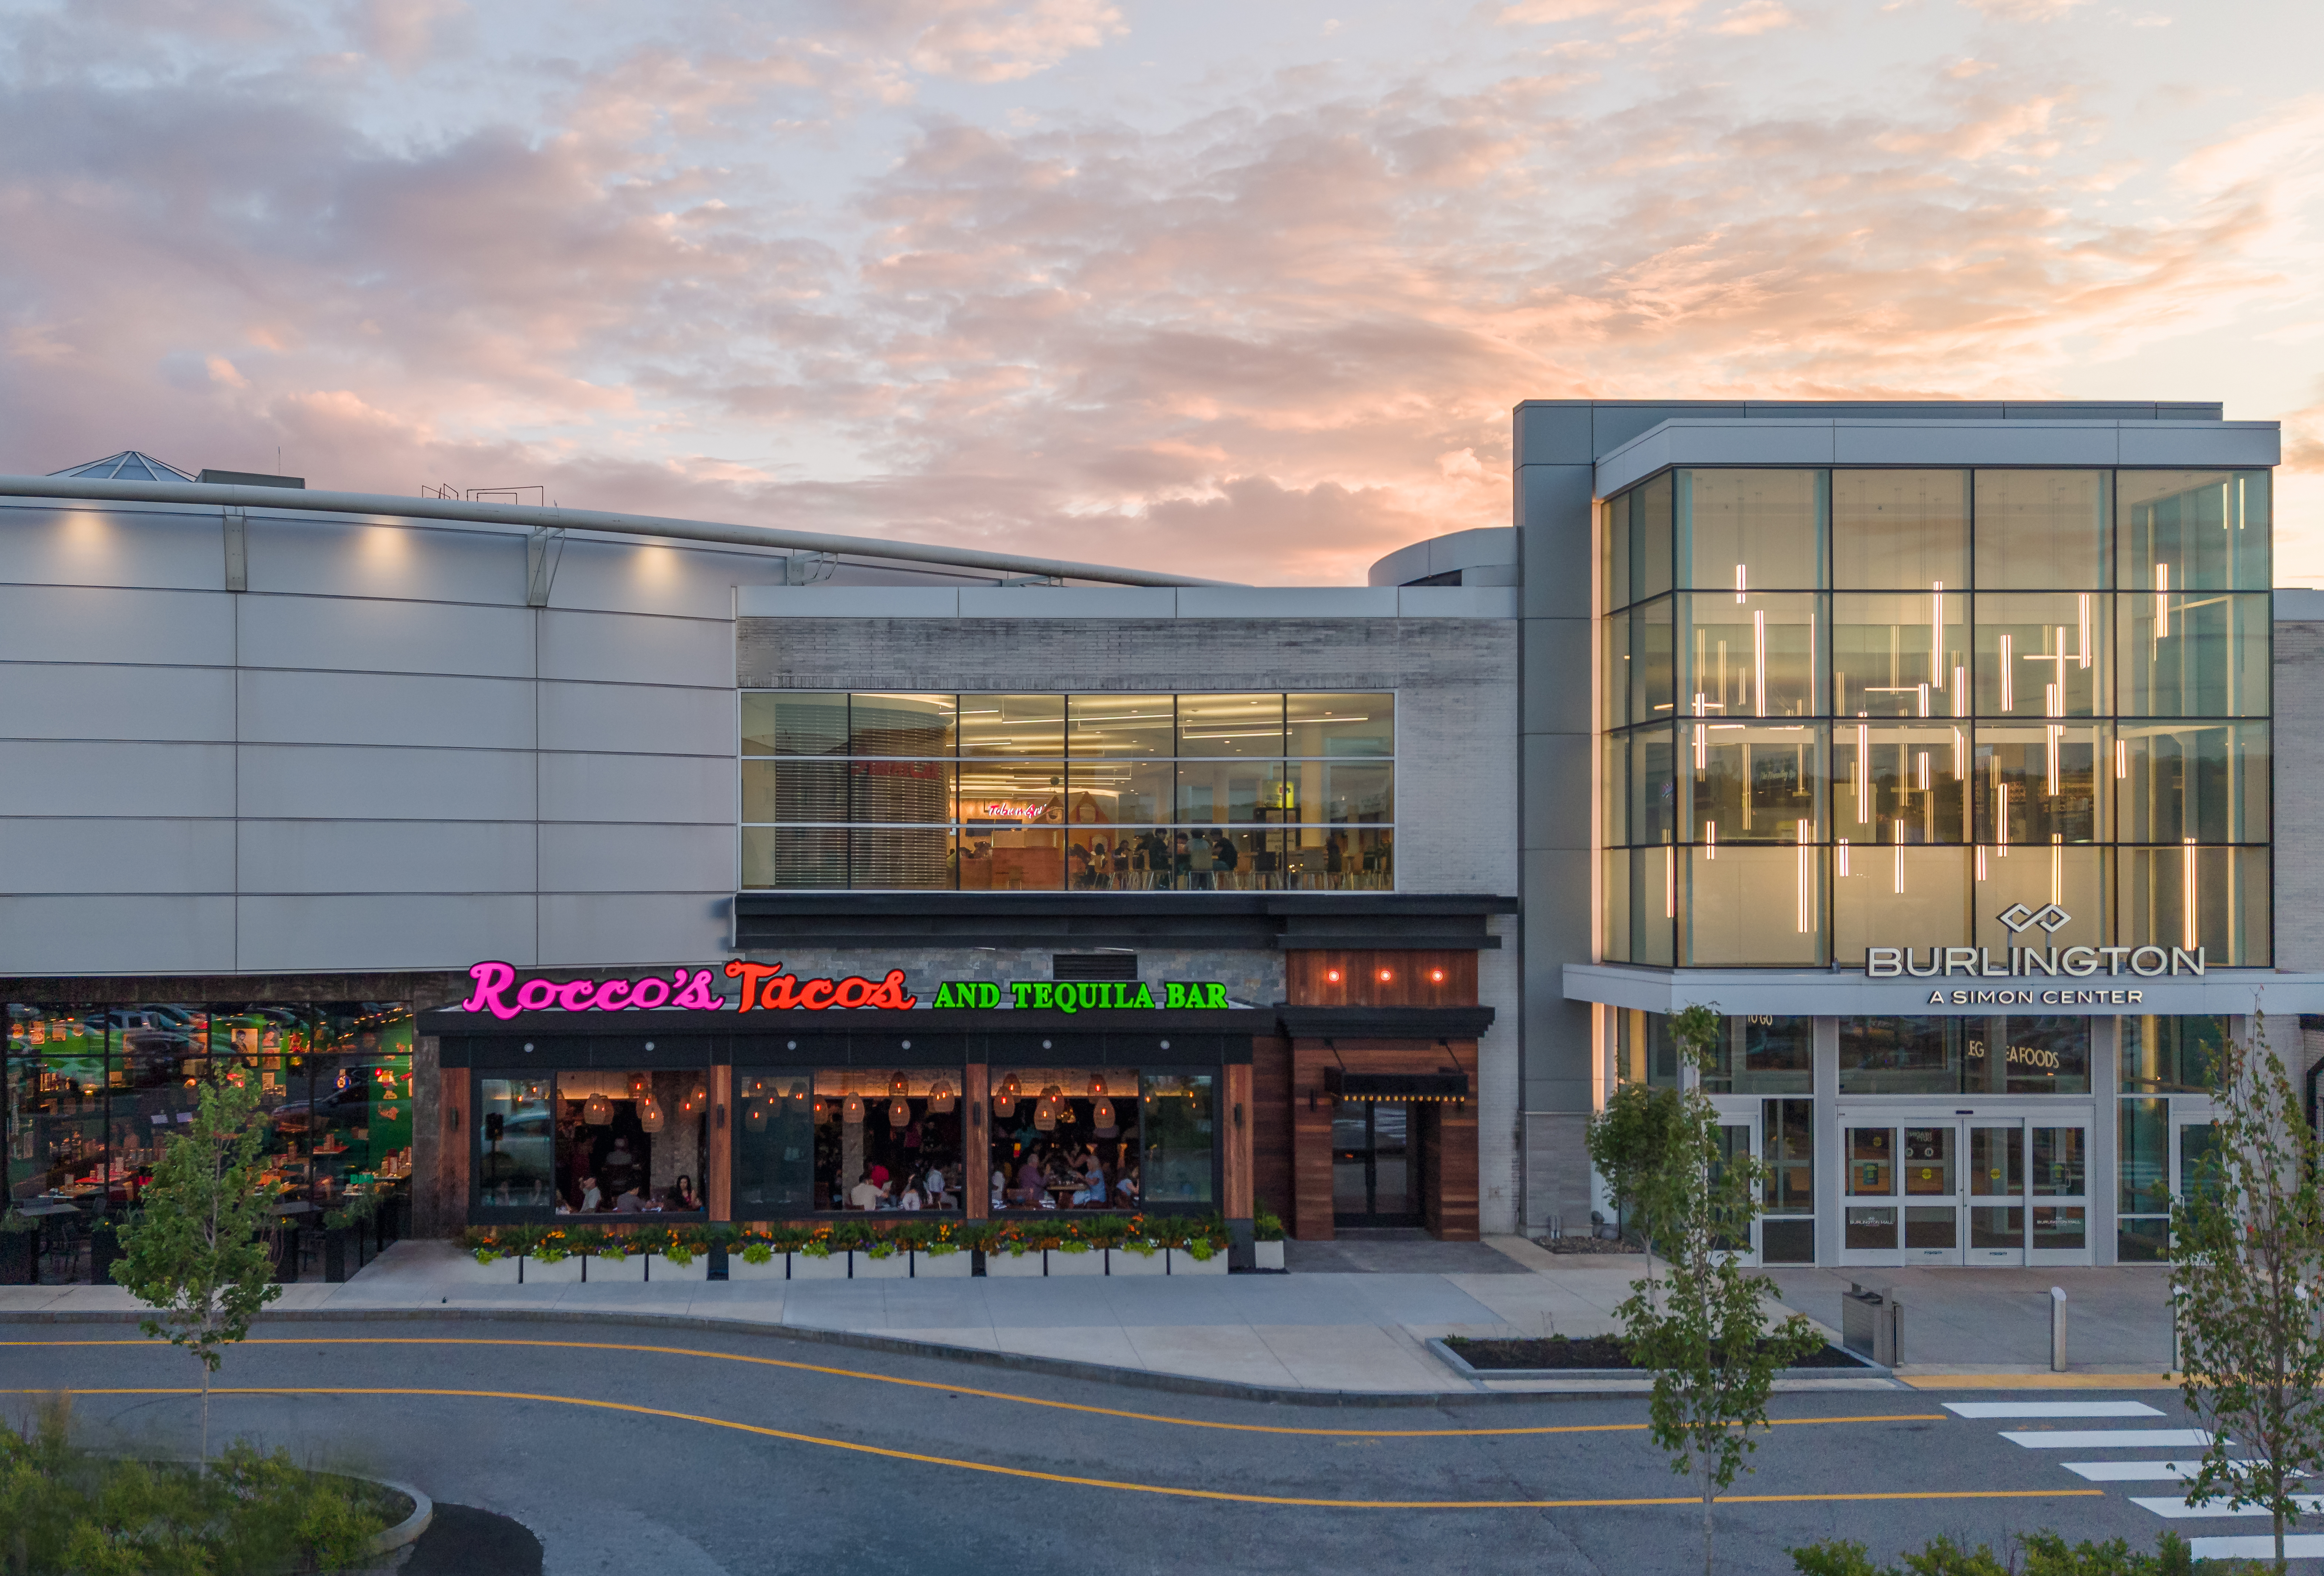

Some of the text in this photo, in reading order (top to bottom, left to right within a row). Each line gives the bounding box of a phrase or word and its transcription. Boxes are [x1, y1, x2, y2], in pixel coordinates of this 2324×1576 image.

[1866, 946, 2205, 976] BURLINGTON
[462, 960, 1229, 1020] Rocco's Tacos AND TEQUILA BAR
[1928, 990, 2143, 1004] A SIMON CENTER
[1760, 1015, 1773, 1026] GO
